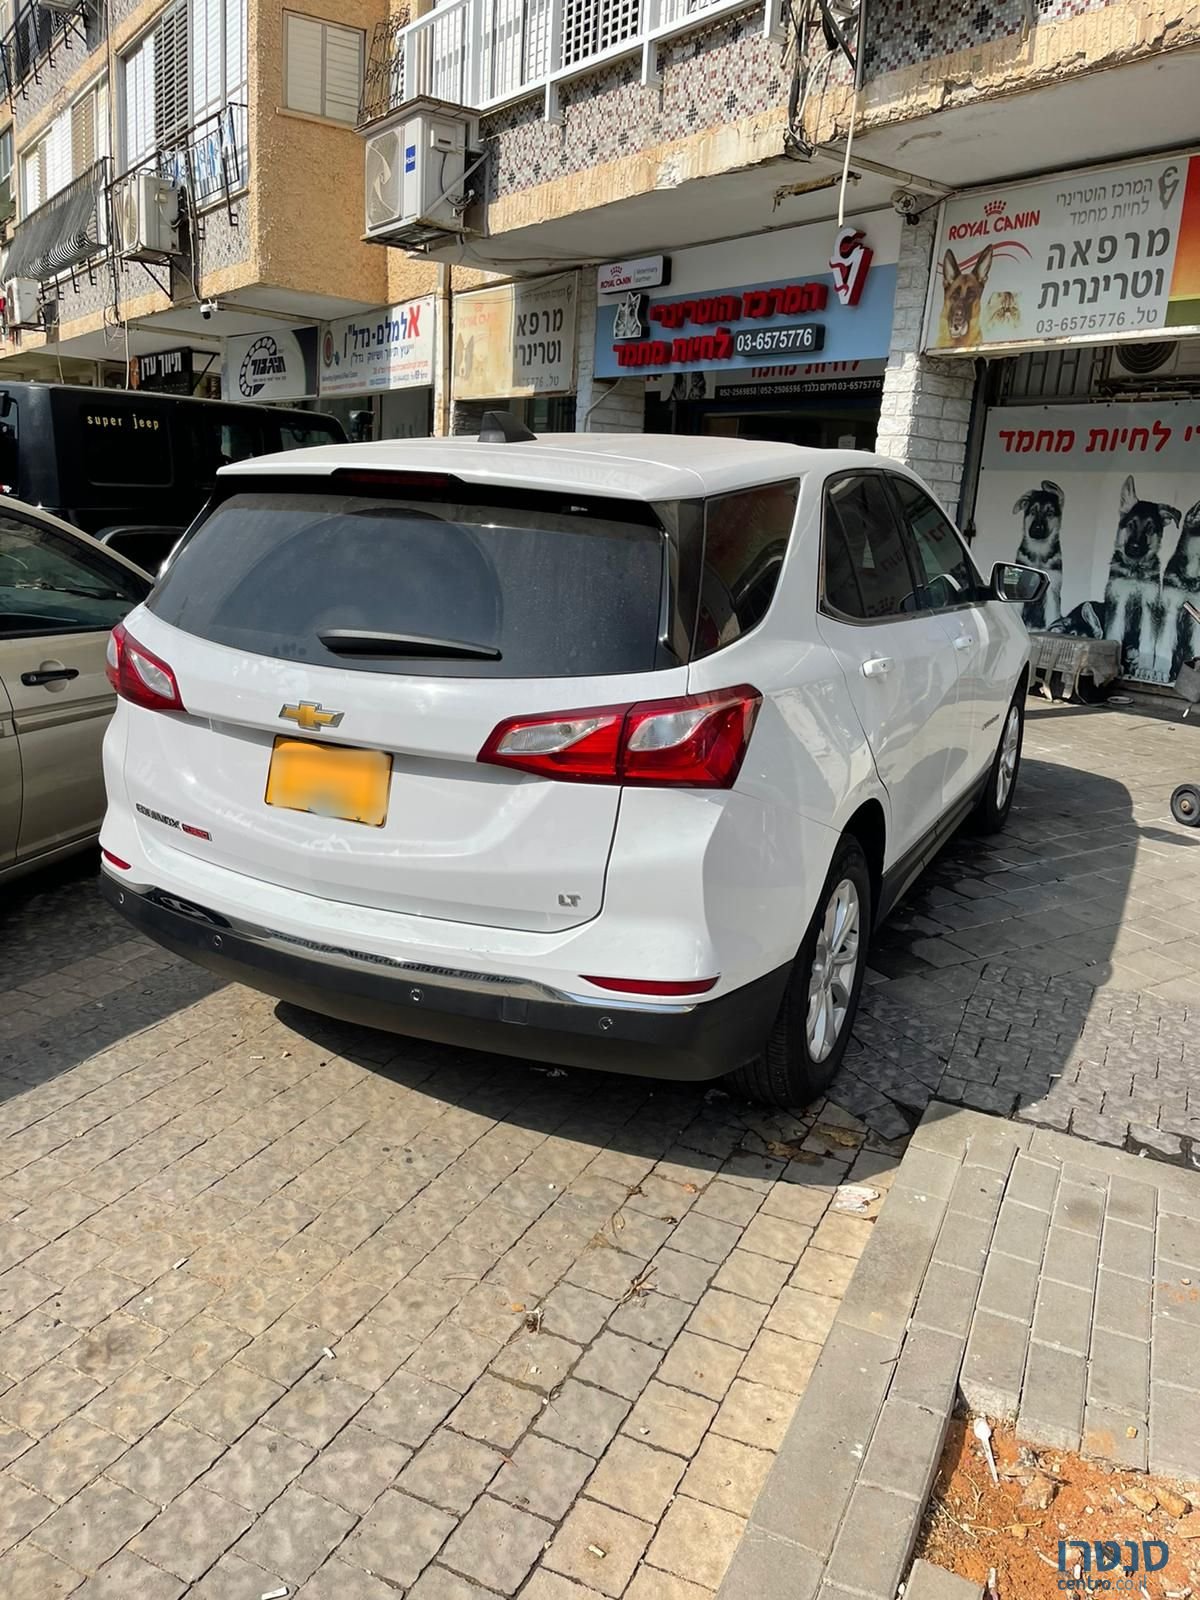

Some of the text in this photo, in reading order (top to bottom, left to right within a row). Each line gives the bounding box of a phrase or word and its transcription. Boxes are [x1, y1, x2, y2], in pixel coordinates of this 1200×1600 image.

[1056, 178, 1154, 207] המרכז הוטרינרי
[948, 209, 1041, 240] ROYAL CANIN
[1069, 196, 1150, 226] לחיות מחמד
[1046, 226, 1171, 271] מרפאה
[1037, 267, 1165, 310] וטרינרית
[650, 282, 828, 329] המרכז הוטרינרי
[1036, 306, 1158, 334] טל. 03-6575776
[613, 326, 734, 367] לחיות מחמד
[736, 327, 813, 352] 03-6575776
[141, 352, 182, 381] תיווך עדן
[820, 383, 837, 392] חירום
[838, 380, 881, 391] 03-6575776
[87, 413, 159, 431] super jeep
[1085, 419, 1172, 453] לחיות
[998, 429, 1076, 453] מחמד
[558, 894, 582, 908] LT
